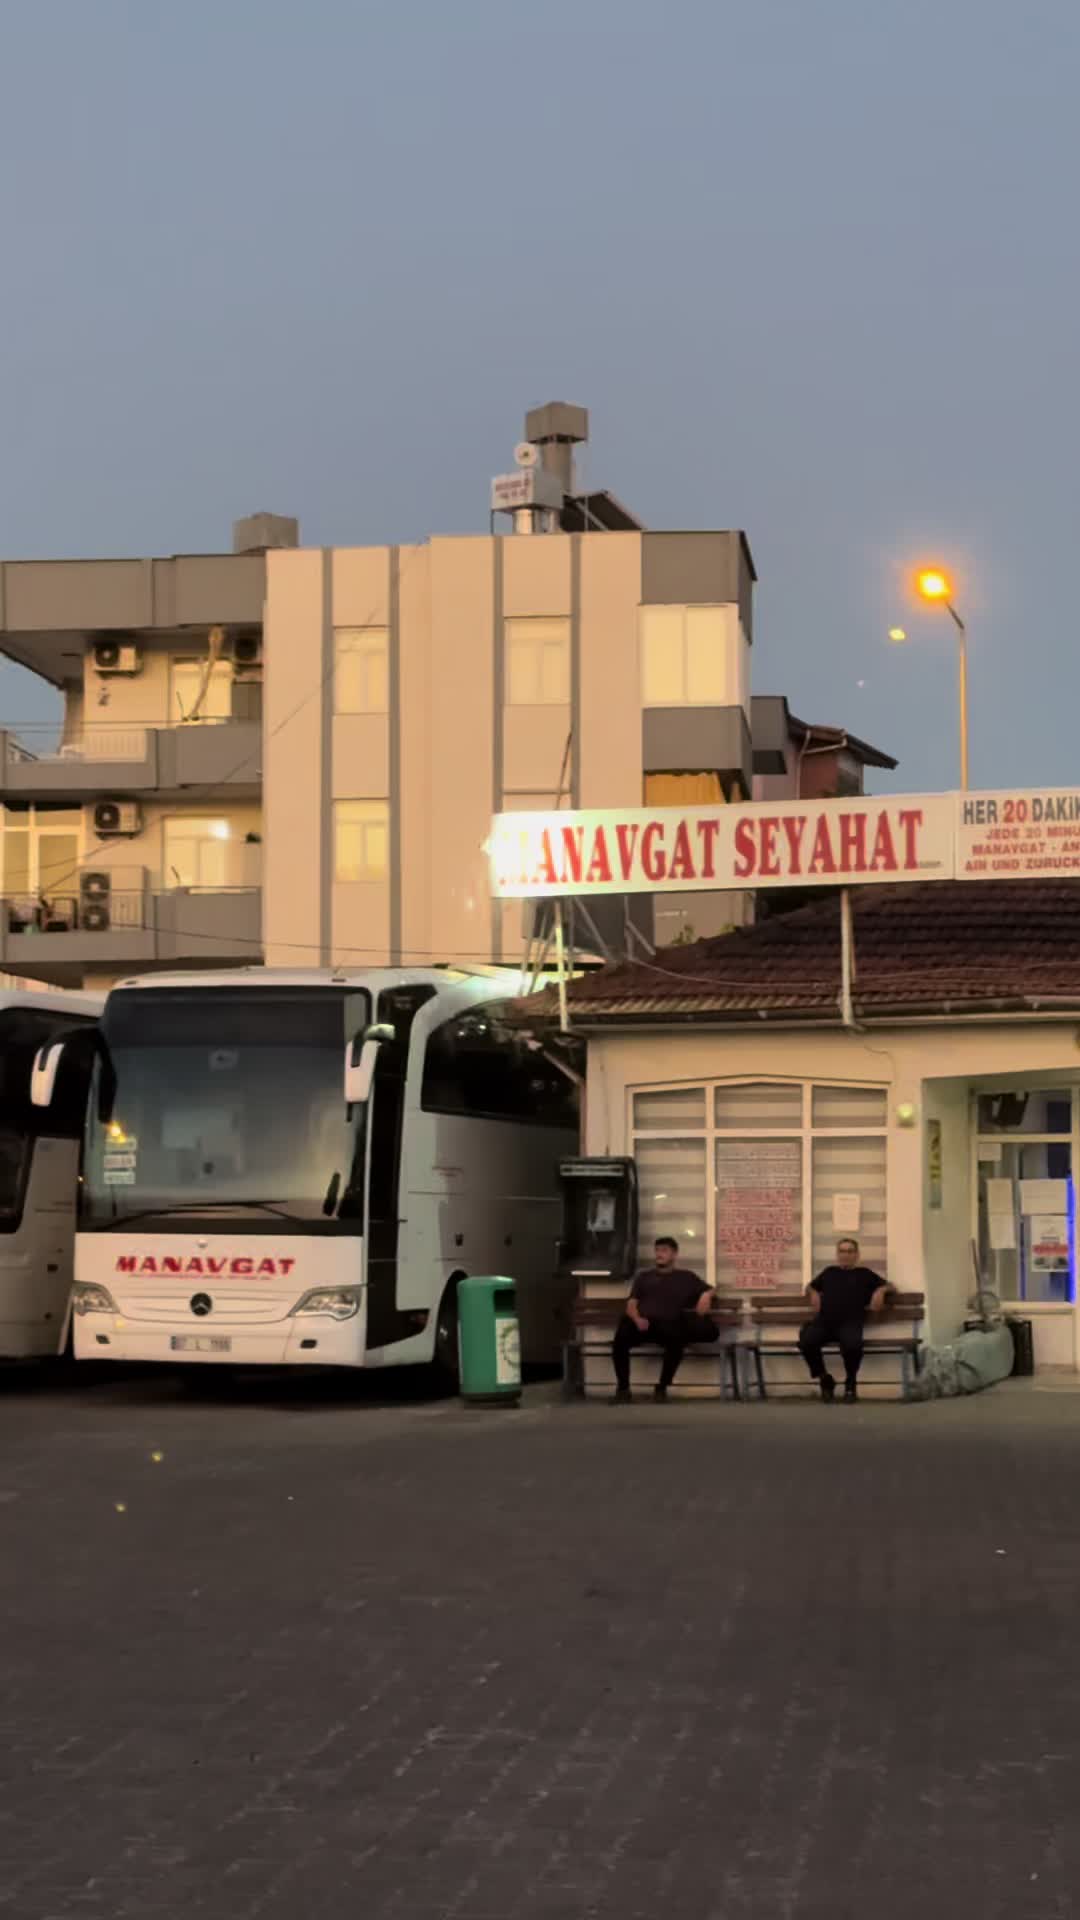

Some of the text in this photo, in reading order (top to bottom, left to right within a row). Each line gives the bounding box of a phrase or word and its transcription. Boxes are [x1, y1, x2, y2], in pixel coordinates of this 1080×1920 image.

[963, 800, 998, 825] HER
[1003, 799, 1028, 823] 20
[500, 809, 923, 885] ANAVGAT SEYAHAT
[972, 842, 1046, 856] MANAVGAT
[116, 1255, 296, 1275] MANAVGAT
